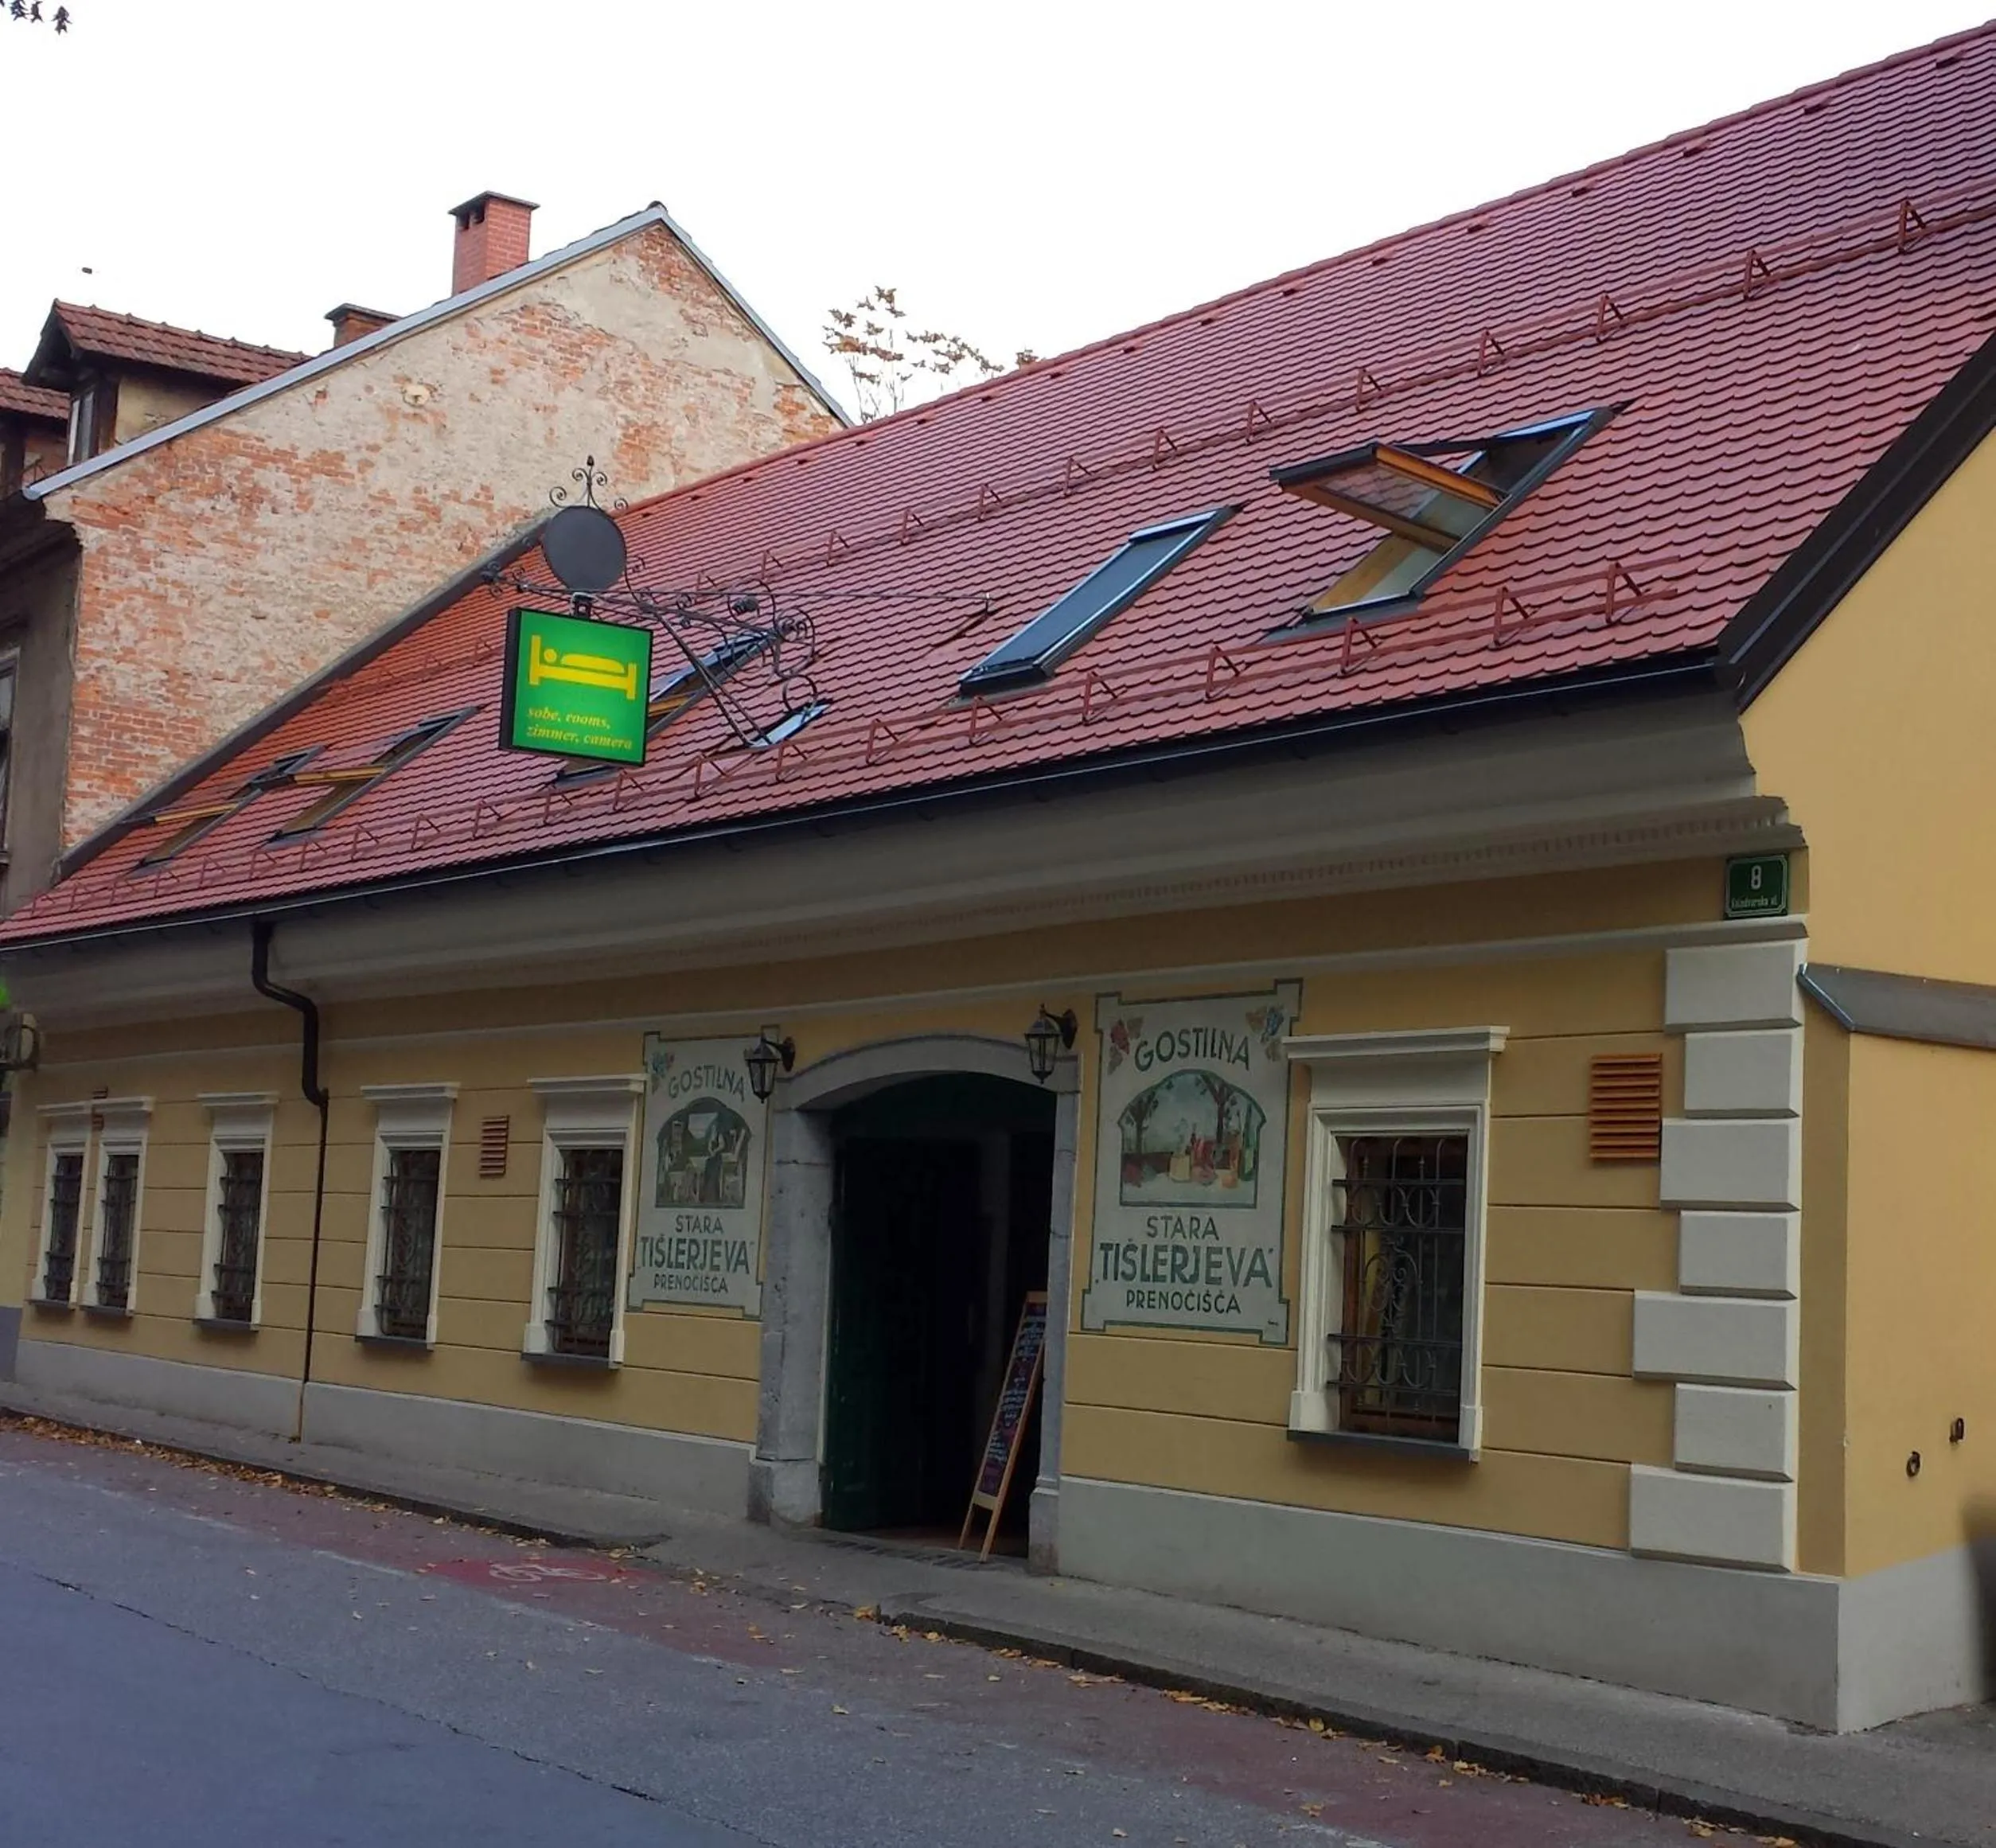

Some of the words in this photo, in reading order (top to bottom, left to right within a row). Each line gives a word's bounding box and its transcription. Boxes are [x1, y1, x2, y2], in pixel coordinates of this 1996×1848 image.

[1751, 864, 1762, 890] 8
[1134, 1026, 1250, 1072] GOSTILNA
[669, 1064, 746, 1104] GOSTILNA
[676, 1214, 725, 1234] STARA
[1146, 1215, 1220, 1242] STARA
